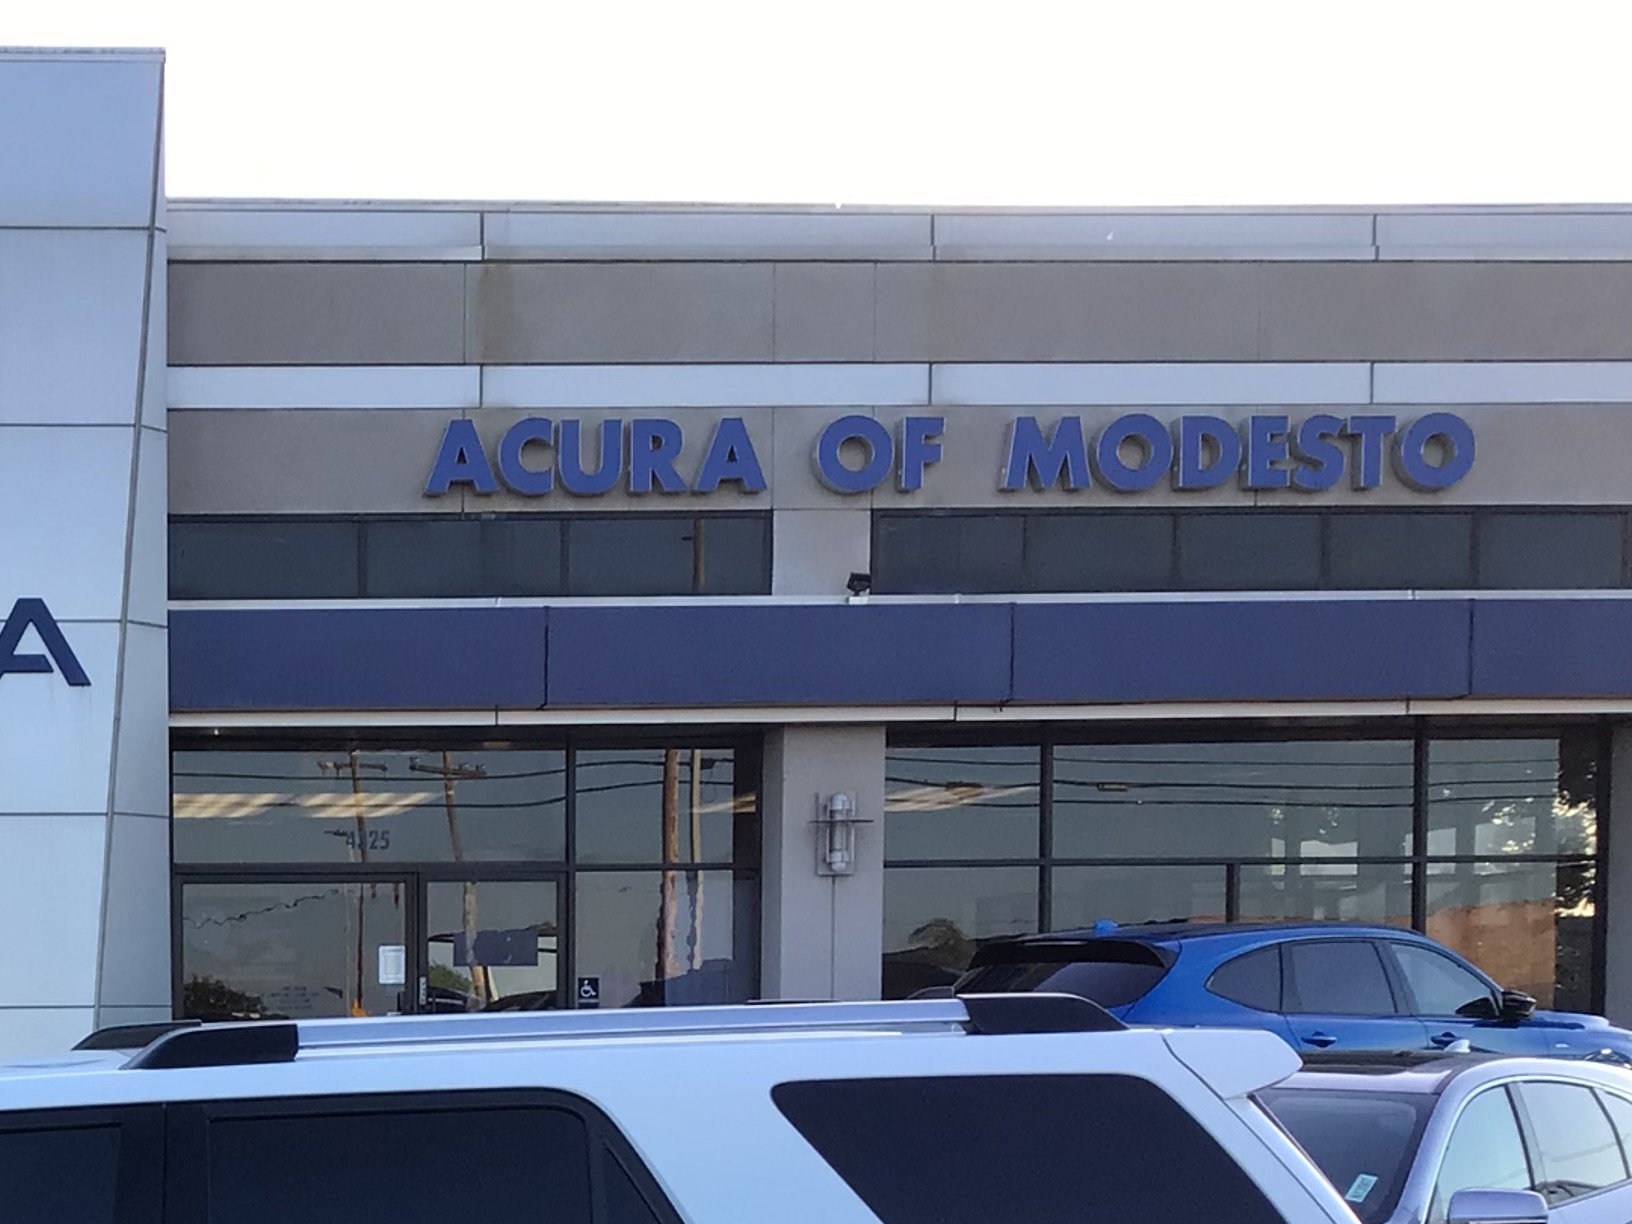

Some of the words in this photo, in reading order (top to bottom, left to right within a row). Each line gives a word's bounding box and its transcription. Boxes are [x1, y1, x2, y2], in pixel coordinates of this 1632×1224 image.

[424, 416, 767, 495] ACURA
[813, 414, 946, 494] OF
[998, 411, 1476, 493] MODESTO
